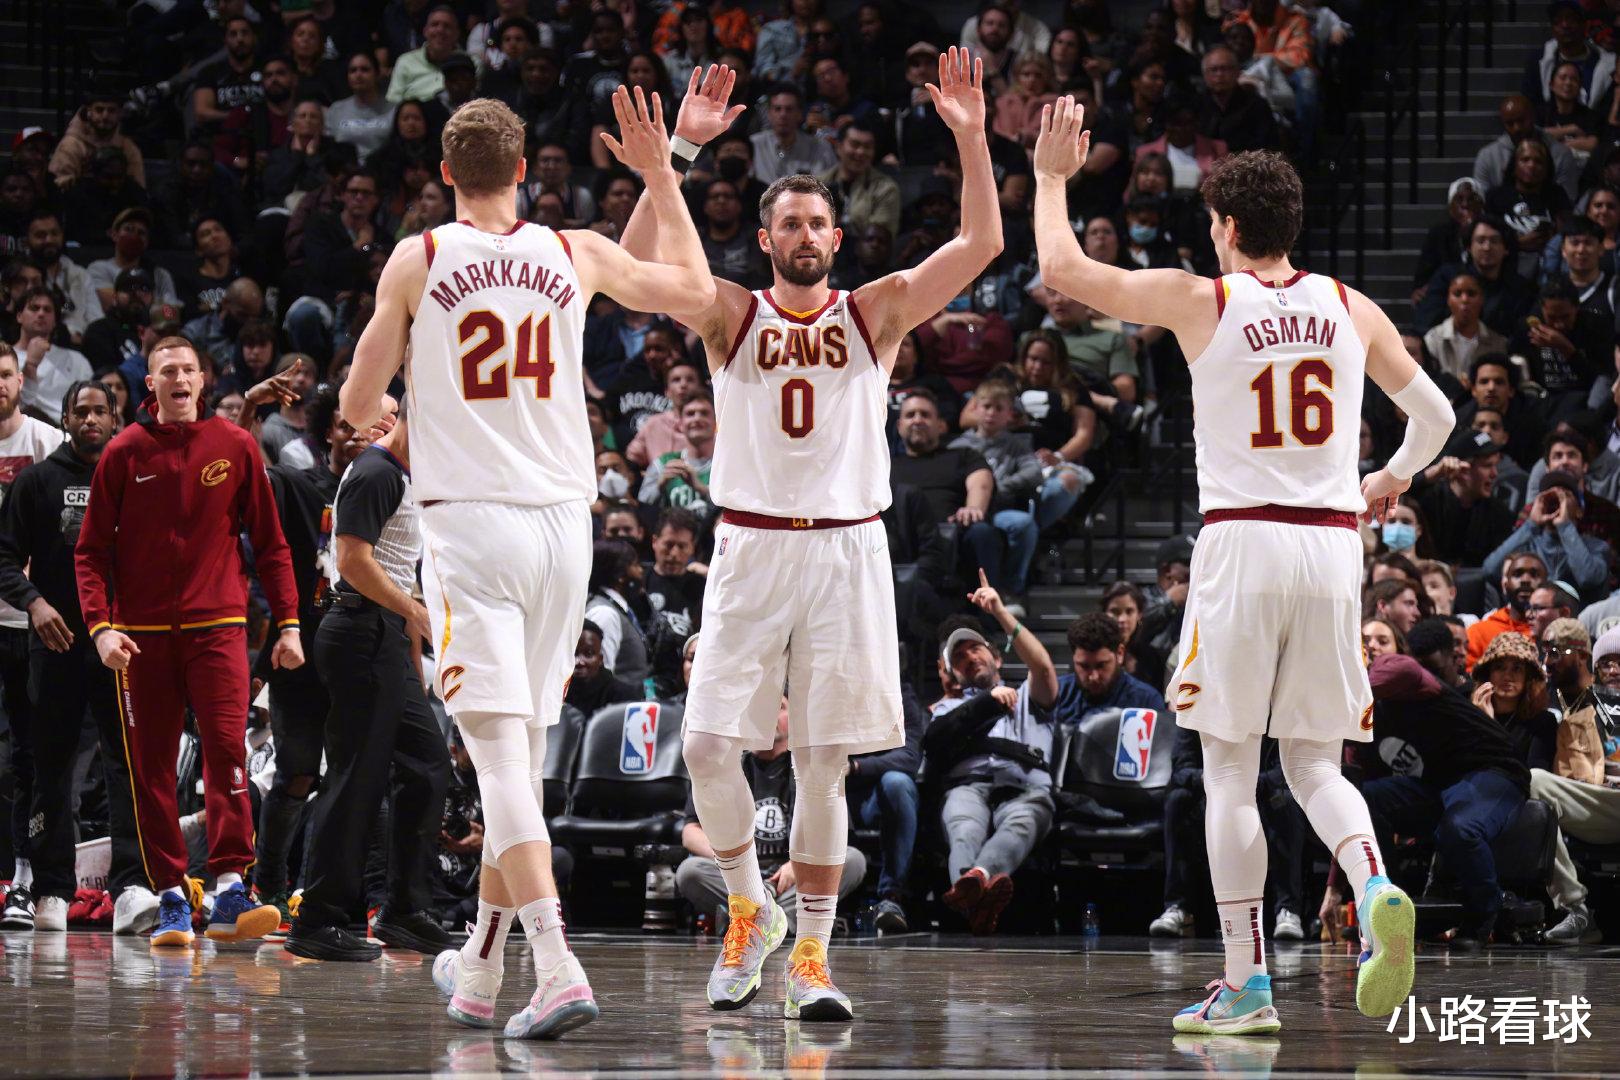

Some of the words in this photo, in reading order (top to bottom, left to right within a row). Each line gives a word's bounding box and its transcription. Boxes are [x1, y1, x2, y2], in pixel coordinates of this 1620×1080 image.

[429, 258, 576, 312] MARKKANEN
[457, 309, 556, 400] 24
[756, 323, 850, 371] CAVS
[1243, 315, 1337, 352] OSMAN
[780, 376, 815, 440] 0
[1250, 357, 1334, 449] 16
